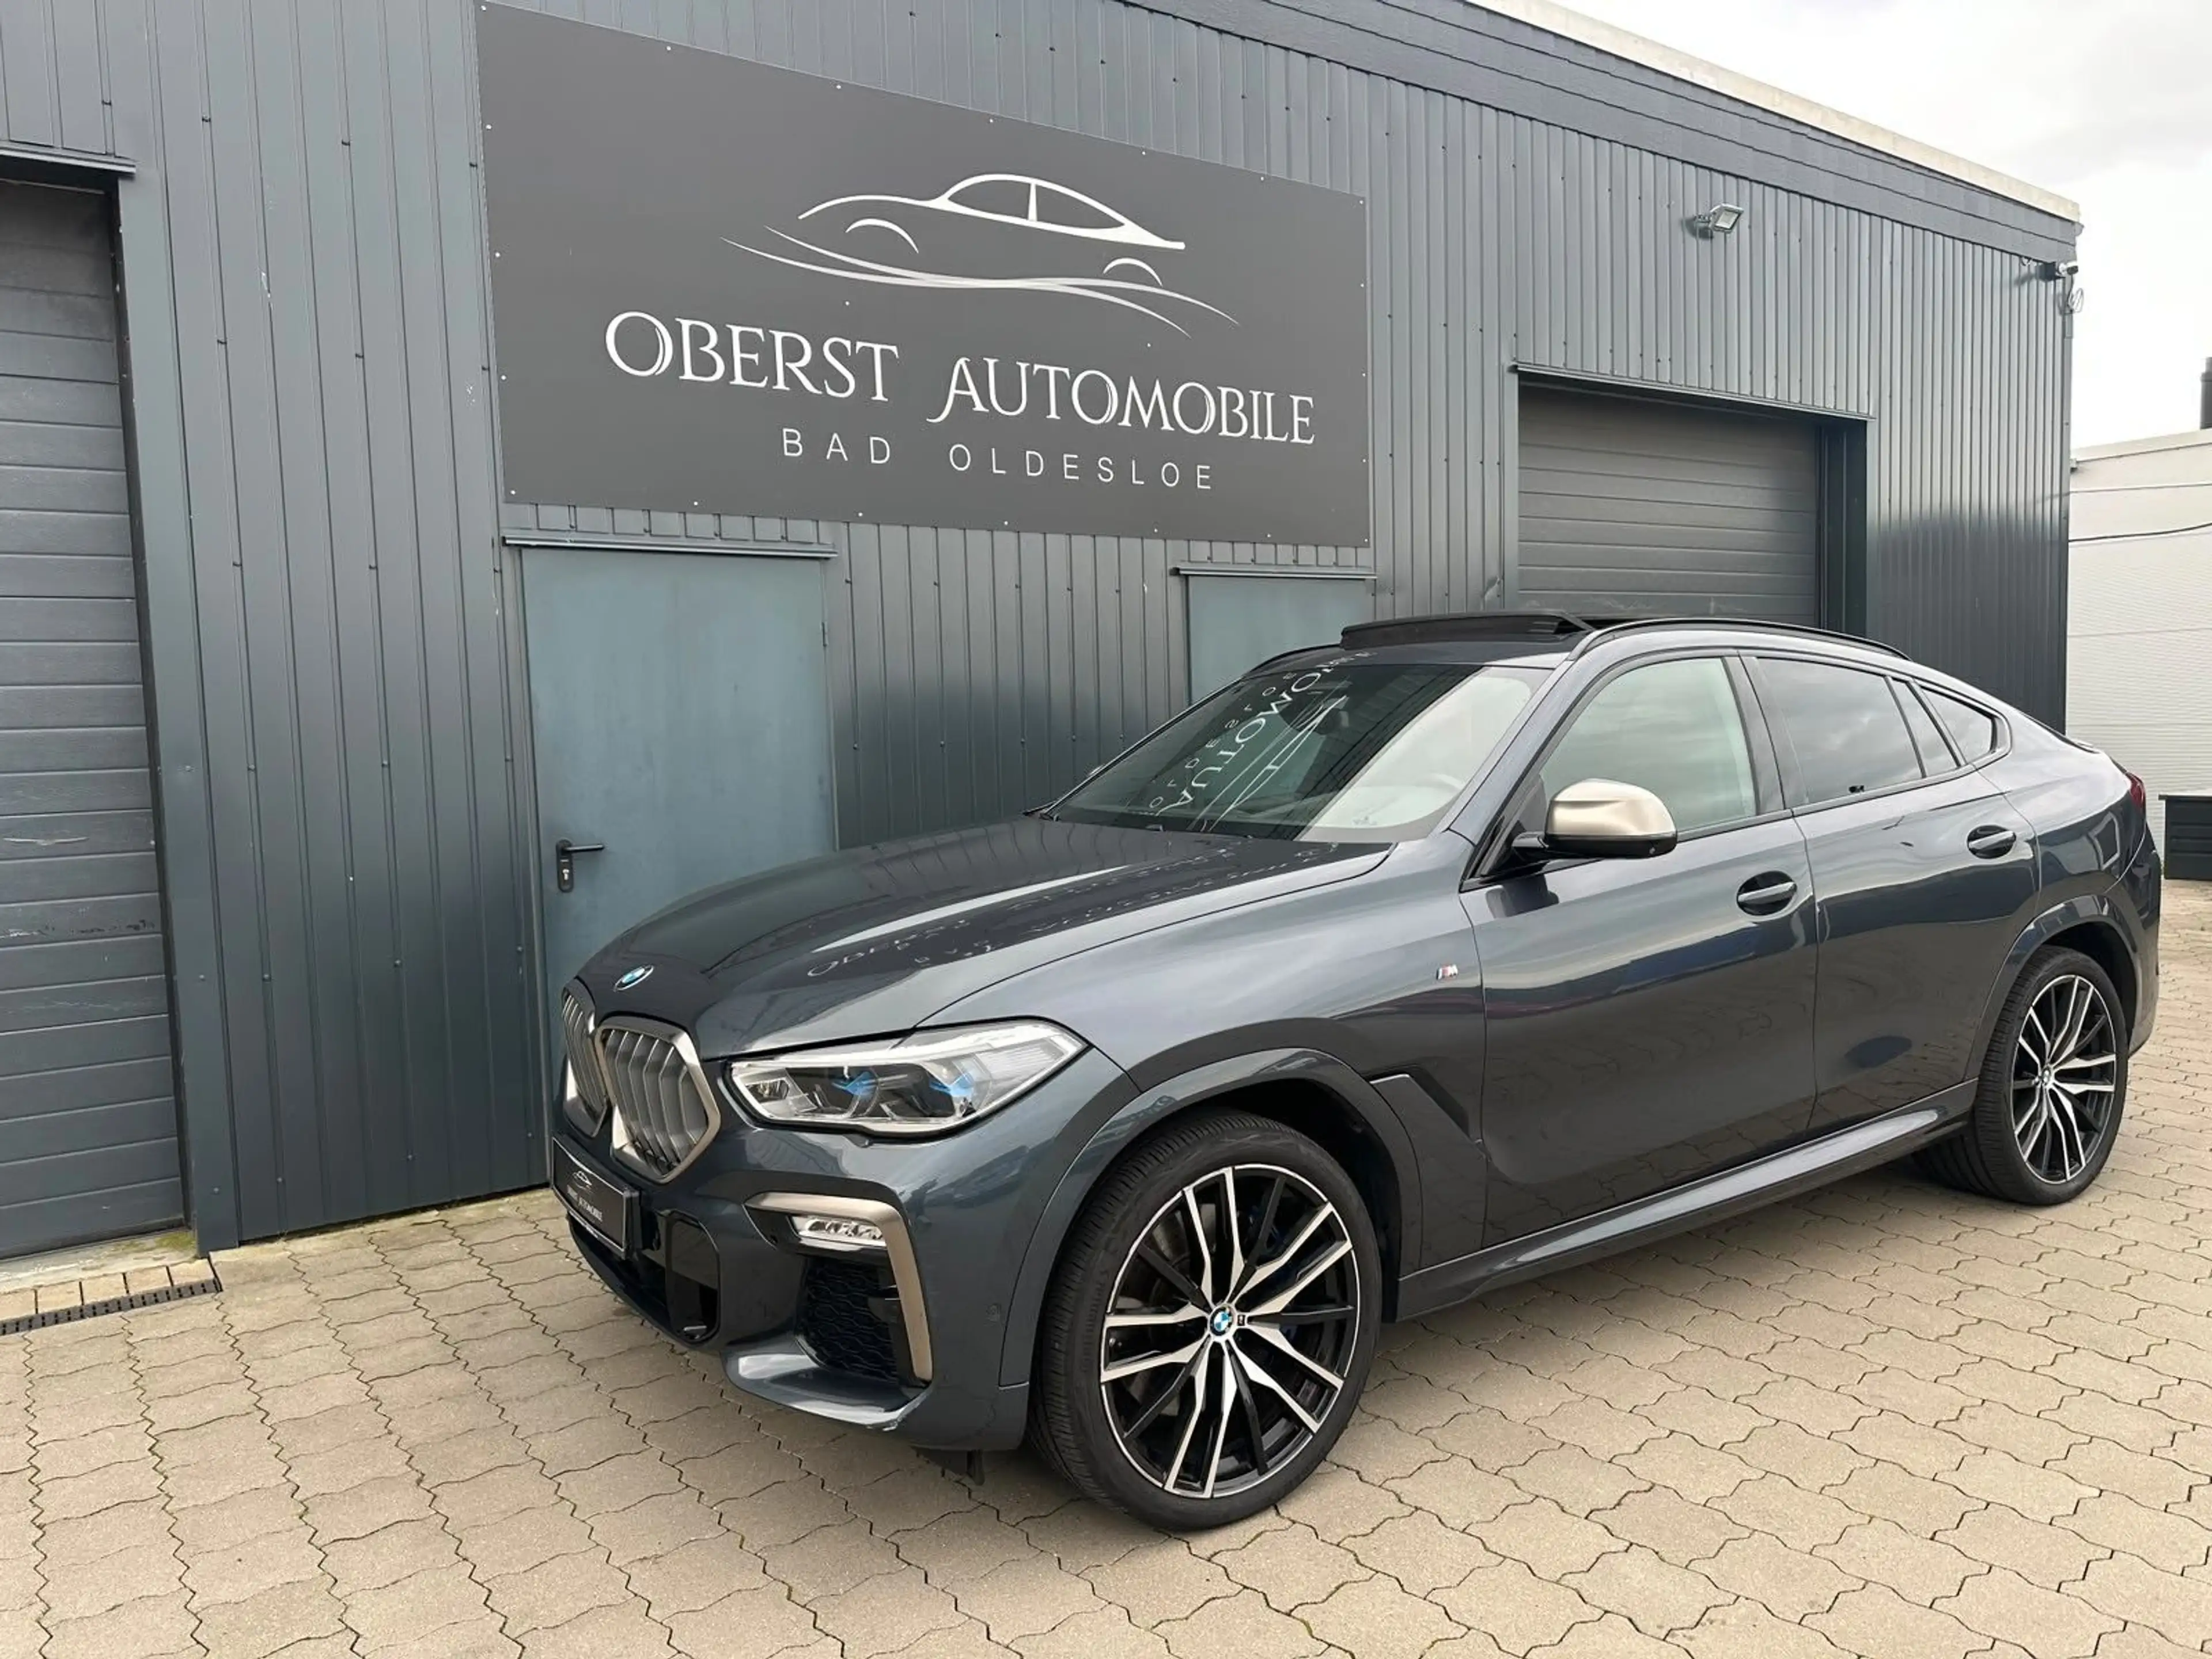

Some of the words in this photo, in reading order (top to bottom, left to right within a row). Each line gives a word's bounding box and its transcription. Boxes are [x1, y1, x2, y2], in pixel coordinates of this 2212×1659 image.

[605, 311, 899, 402] OBERST
[926, 357, 1316, 445] AUTOMOBILE
[782, 427, 891, 465] BAD
[949, 443, 1211, 490] OLDESLOE
